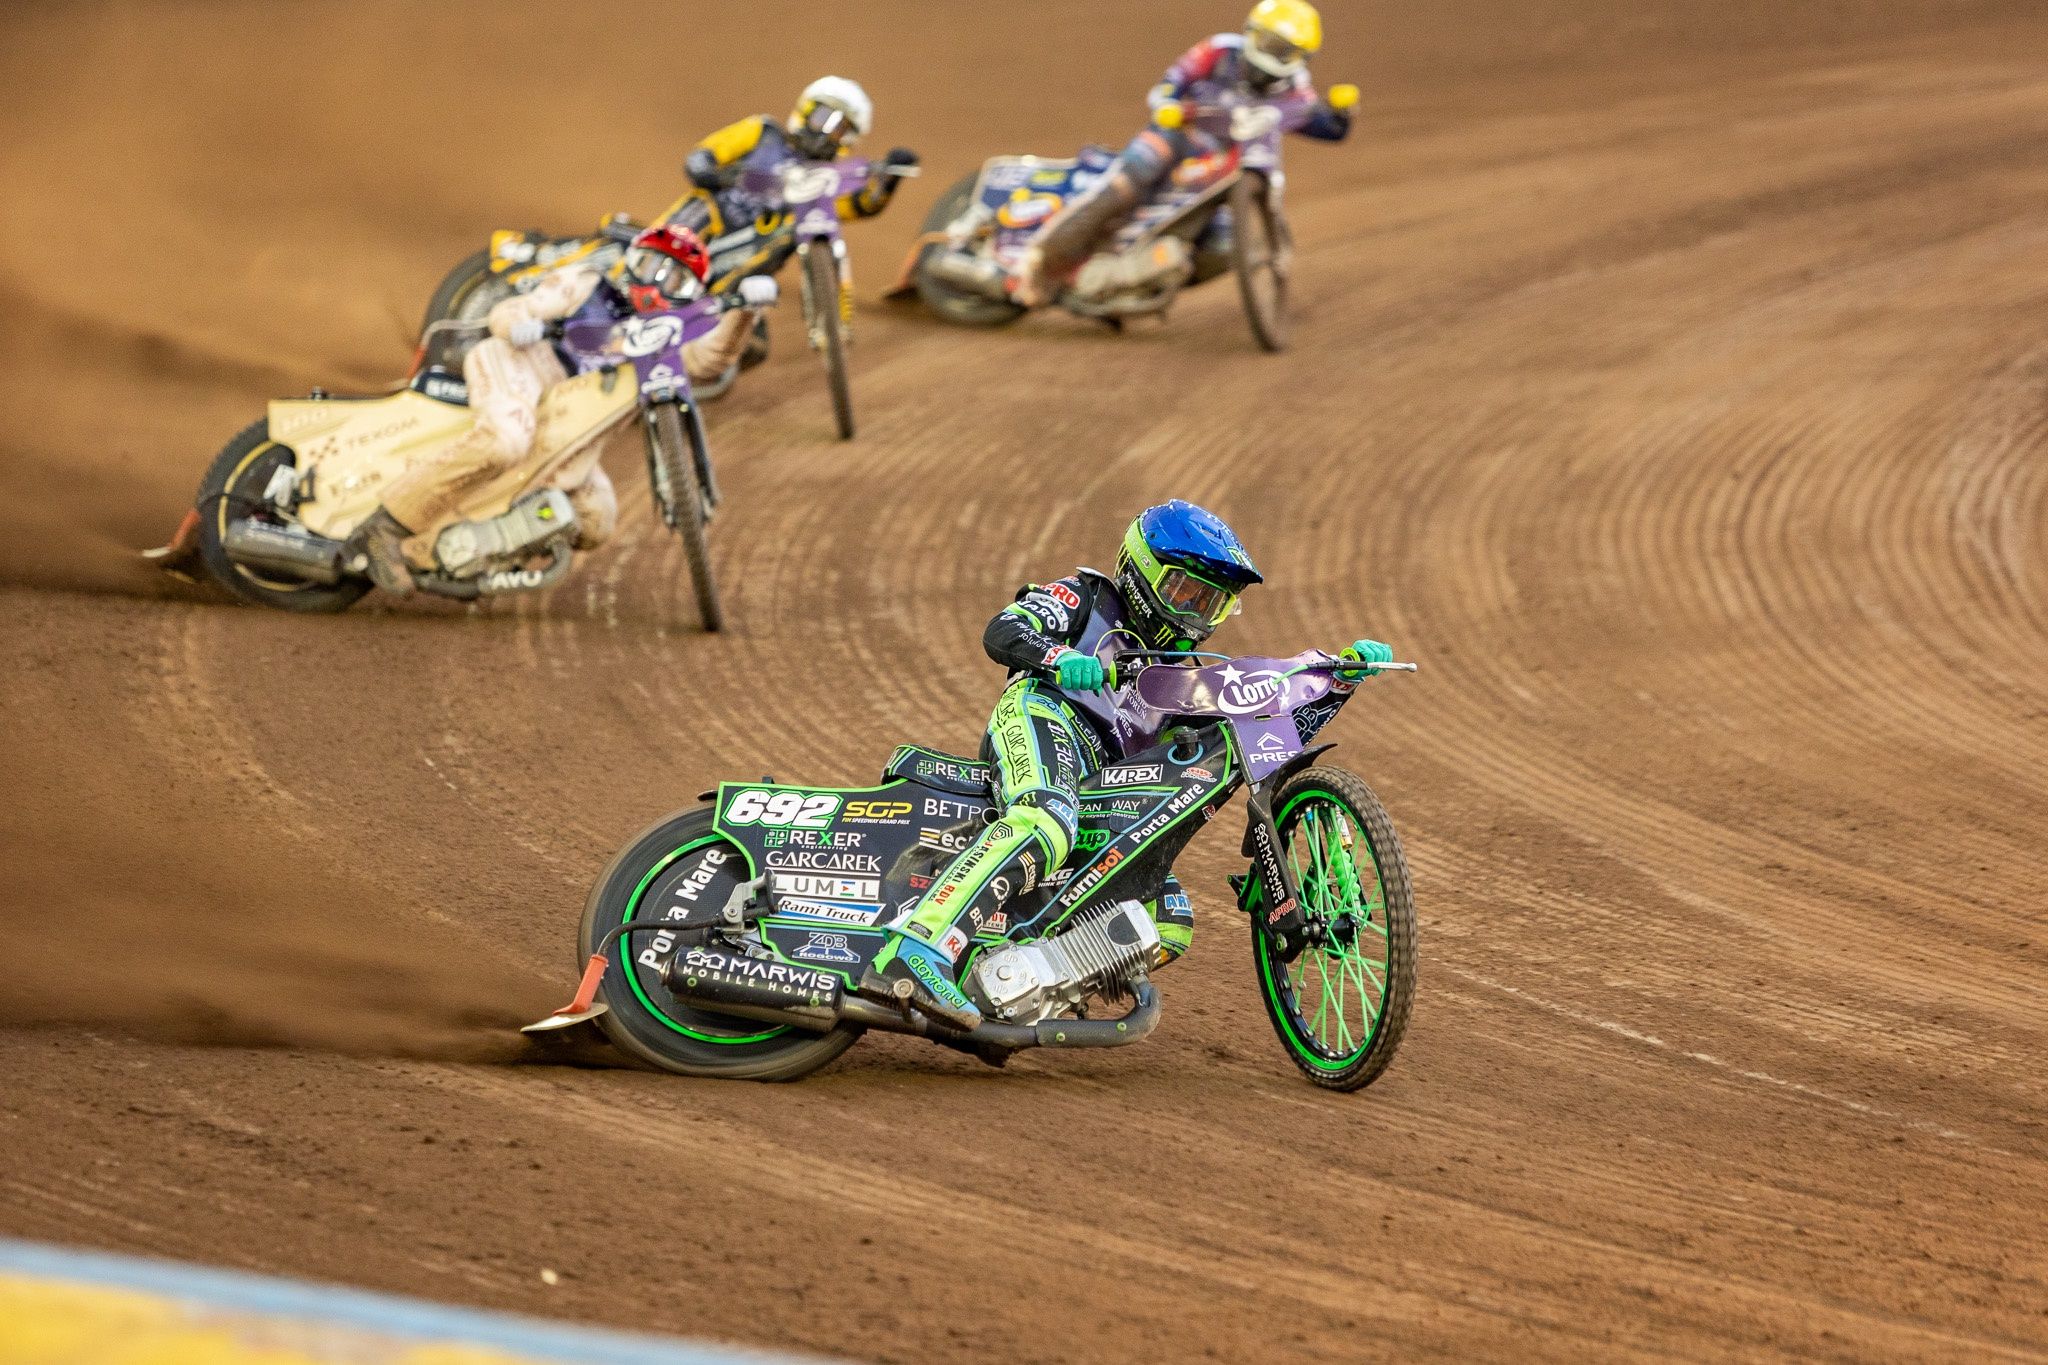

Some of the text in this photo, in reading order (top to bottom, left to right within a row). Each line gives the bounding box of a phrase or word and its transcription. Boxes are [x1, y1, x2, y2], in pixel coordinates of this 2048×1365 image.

[936, 762, 992, 782] REXER
[1103, 768, 1160, 784] KAREX
[725, 788, 842, 829] 692
[842, 801, 913, 818] SGP
[1111, 800, 1141, 811] WAY
[1130, 783, 1205, 845] Porta Mare
[789, 830, 862, 848] REXER
[765, 850, 882, 873] GARCAREK
[1264, 844, 1285, 901] MARWIS
[1059, 848, 1125, 907] Furnisol
[638, 849, 727, 972] Pora Mare
[780, 899, 870, 924] Rami Truck
[682, 965, 833, 1003] MOBILE HOMES
[729, 957, 836, 991] MARWIS
